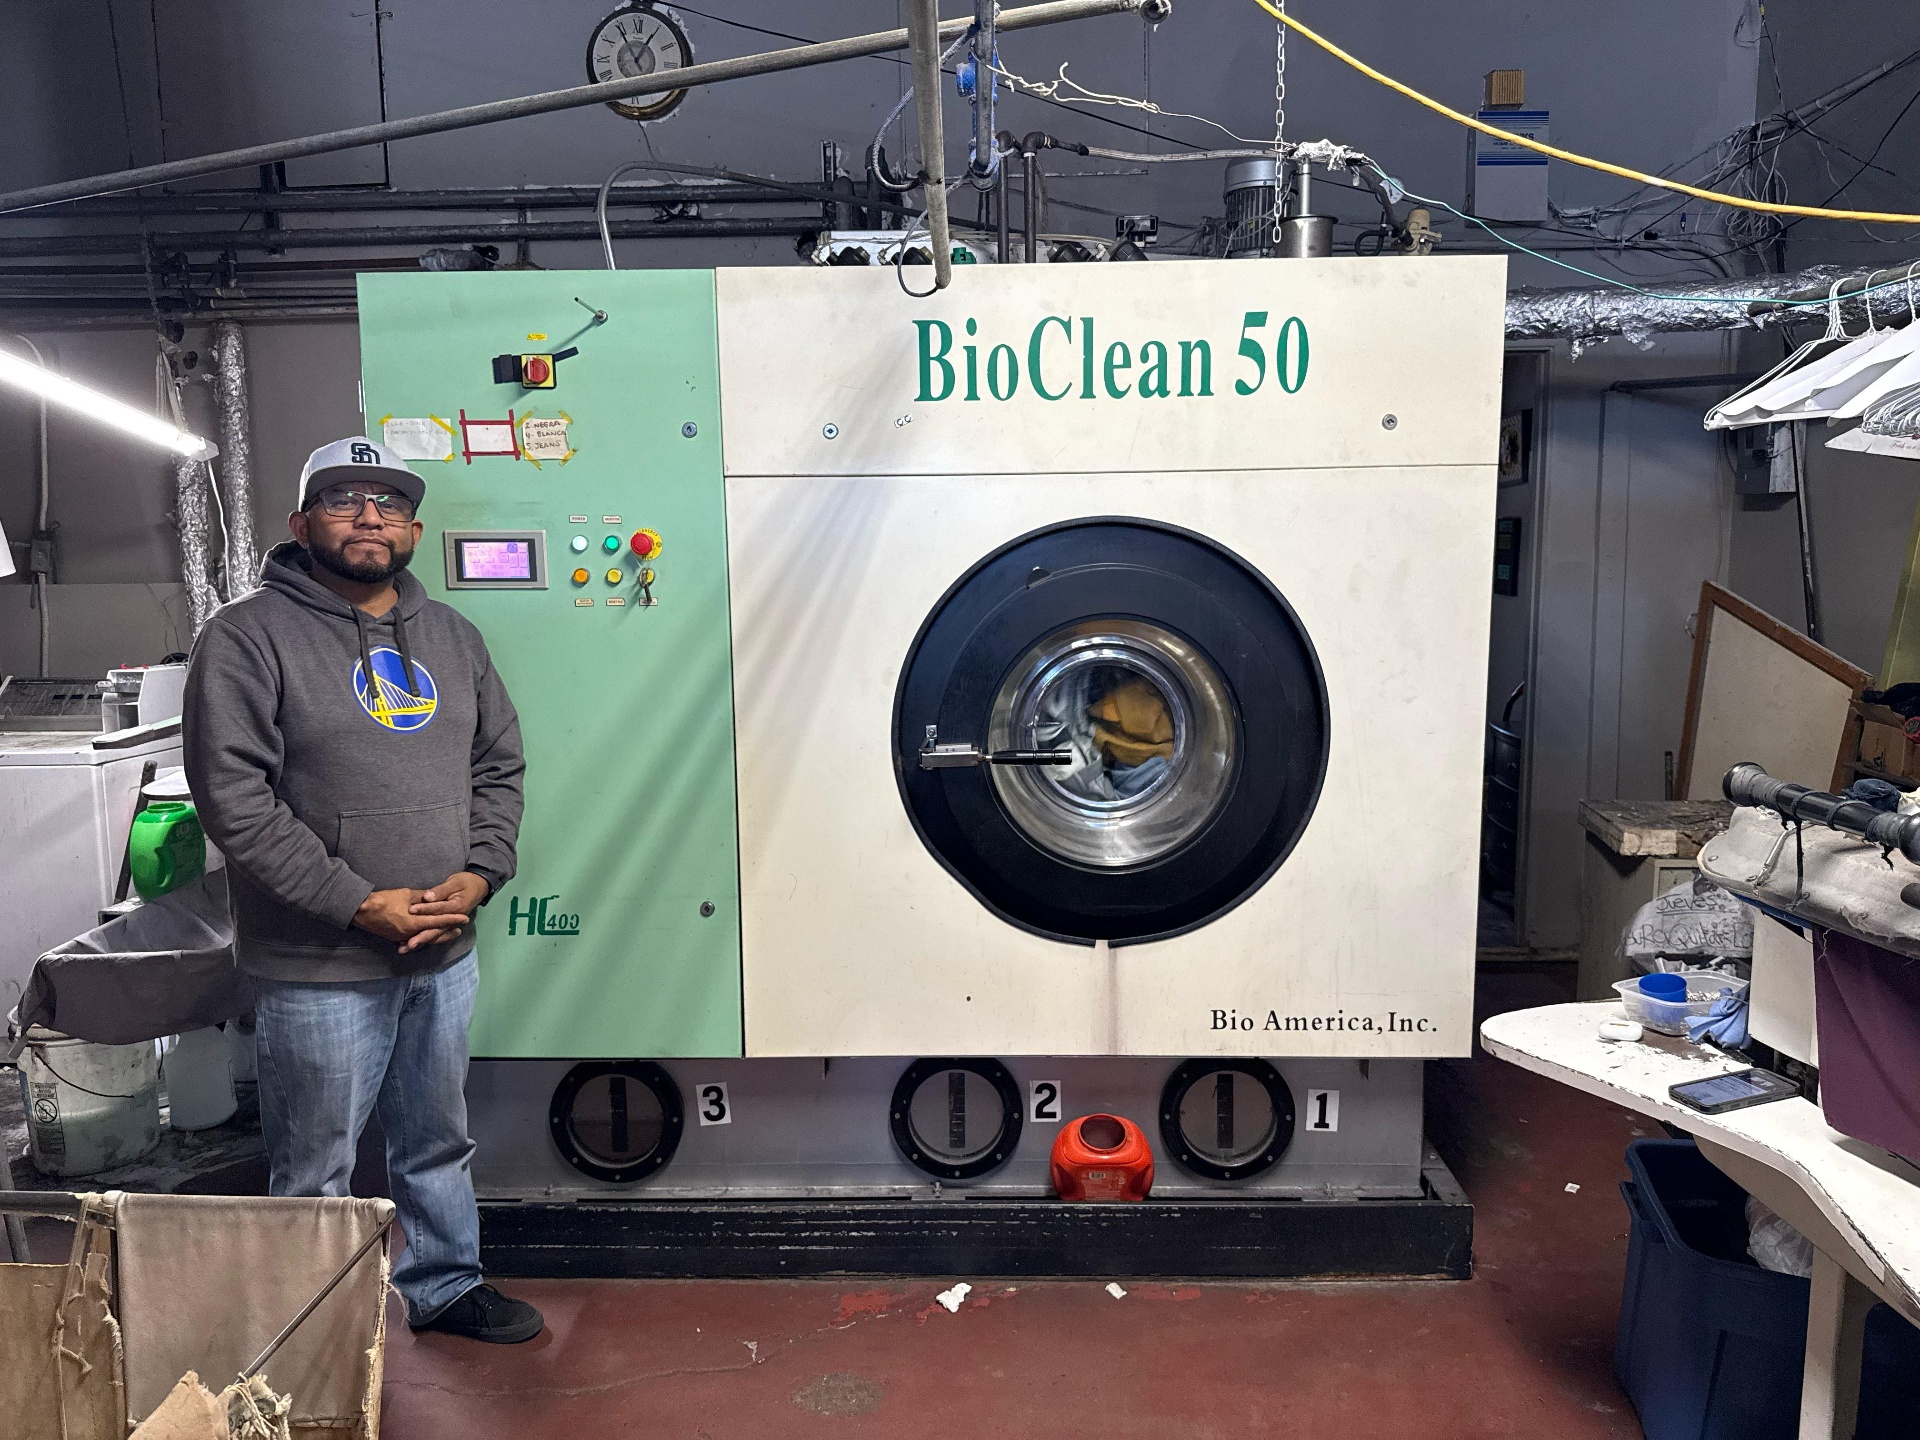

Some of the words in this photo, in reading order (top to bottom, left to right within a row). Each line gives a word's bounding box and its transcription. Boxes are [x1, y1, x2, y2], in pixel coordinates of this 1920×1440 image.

[912, 315, 1214, 402] BioClean
[1235, 311, 1310, 396] 50
[534, 421, 561, 429] NEGRA
[534, 440, 562, 449] JEANS
[546, 913, 580, 930] 400
[1210, 1009, 1254, 1031] Bio
[702, 1085, 727, 1122] 3
[1034, 1082, 1057, 1119] 2
[1313, 1092, 1330, 1129] 1
